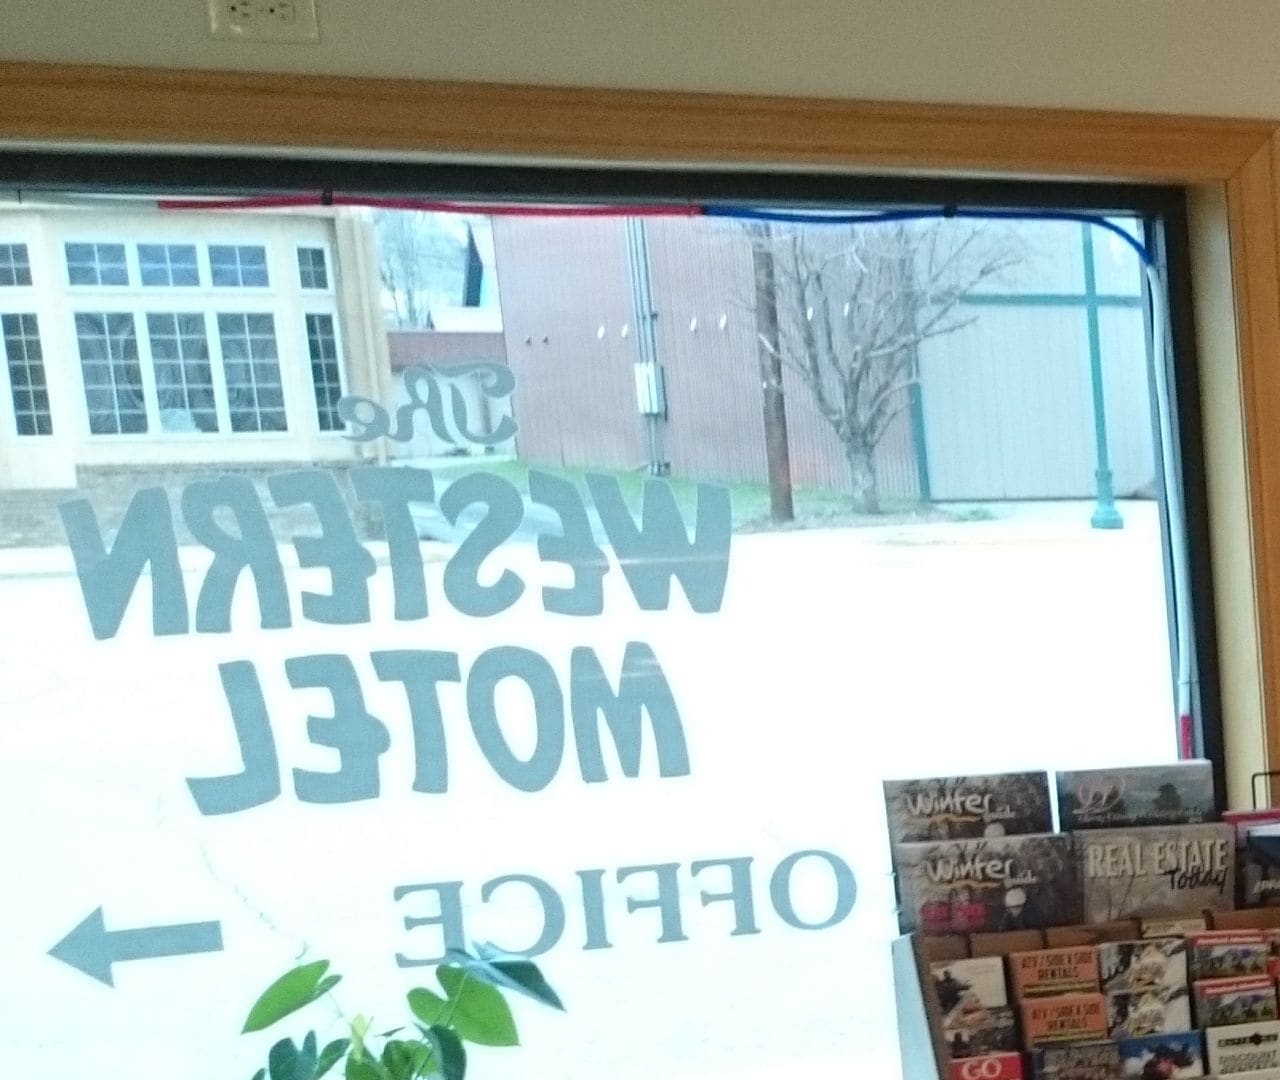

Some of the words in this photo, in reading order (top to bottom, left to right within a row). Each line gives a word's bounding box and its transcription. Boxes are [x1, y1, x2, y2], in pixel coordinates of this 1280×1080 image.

[905, 787, 993, 817] Winter
[925, 852, 1014, 884] Winter
[1087, 839, 1147, 879] REAL
[1154, 837, 1229, 876] ESTATE
